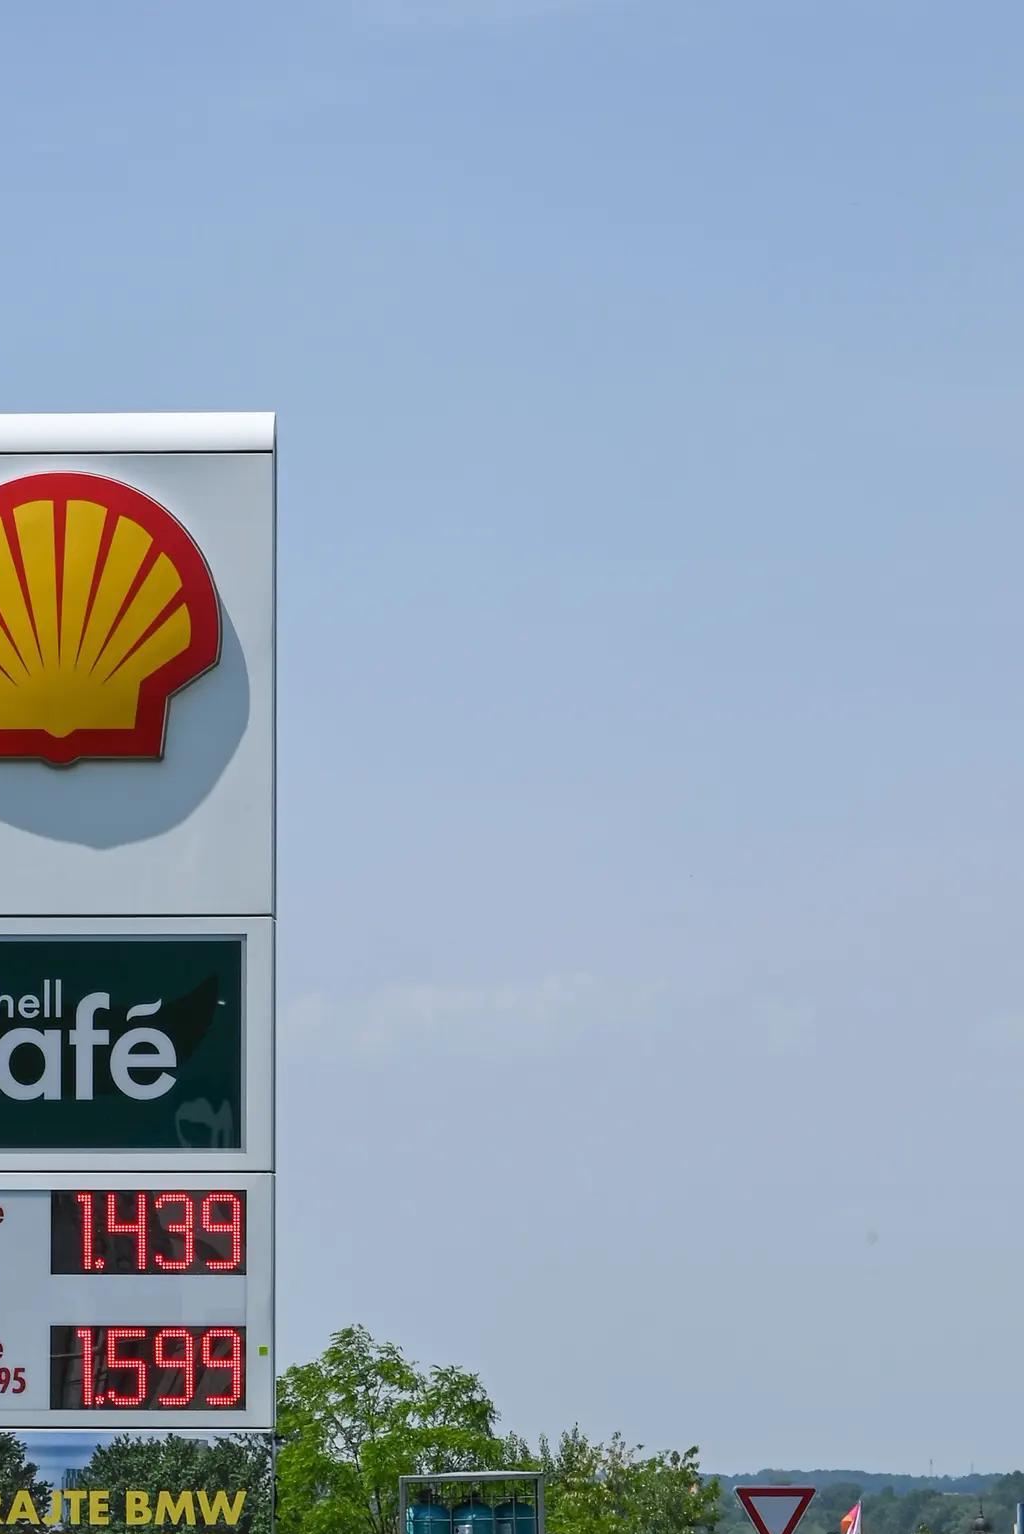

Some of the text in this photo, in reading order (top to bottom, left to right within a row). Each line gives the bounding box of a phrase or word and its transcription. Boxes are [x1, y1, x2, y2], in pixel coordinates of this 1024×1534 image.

[77, 1192, 241, 1271] 1.439
[77, 1328, 241, 1407] 1.599
[125, 1489, 247, 1526] BMW
